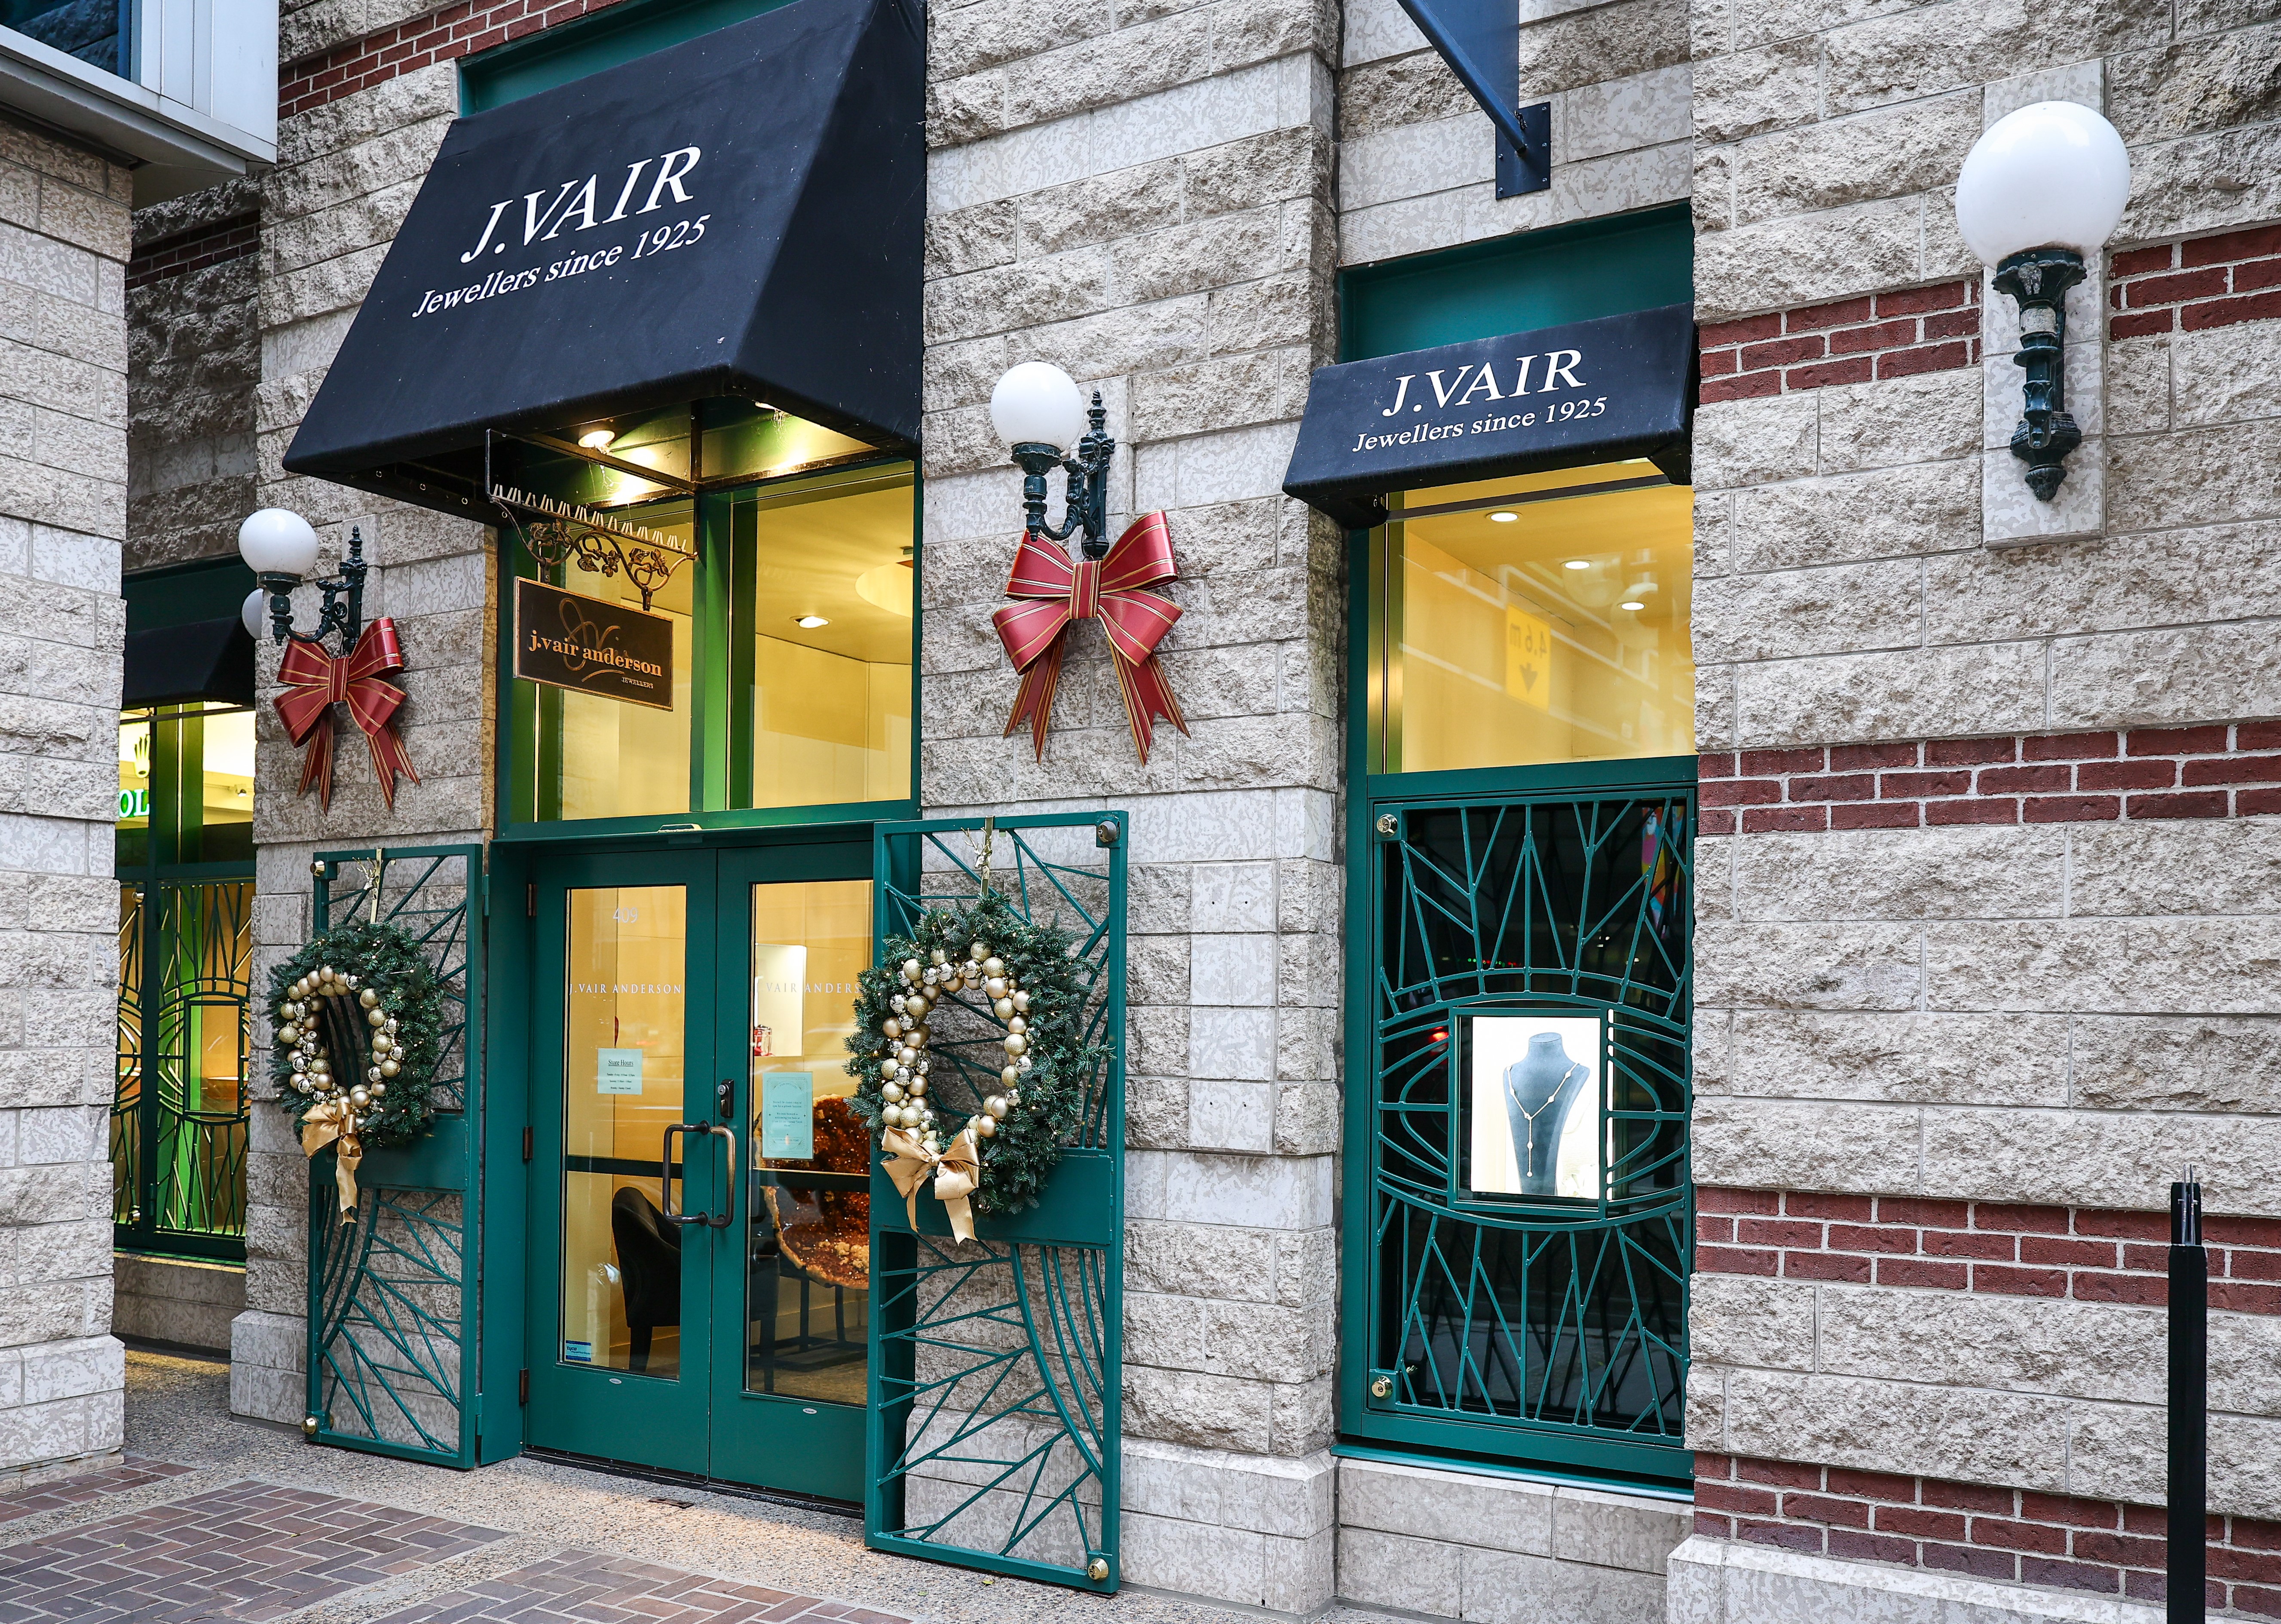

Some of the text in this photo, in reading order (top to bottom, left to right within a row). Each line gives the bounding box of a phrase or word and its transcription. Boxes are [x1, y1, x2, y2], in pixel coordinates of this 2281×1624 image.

[461, 147, 701, 263] J.VAIR
[412, 214, 711, 318] Jewellers since 1925
[1382, 349, 1586, 416] J.VAIR
[1352, 397, 1607, 452] Jewellers since 1925
[529, 630, 662, 677] j.vair anderson
[622, 676, 653, 689] JEWELLERS
[612, 907, 638, 924] 409
[569, 983, 681, 995] J.VAIR ANDERSON
